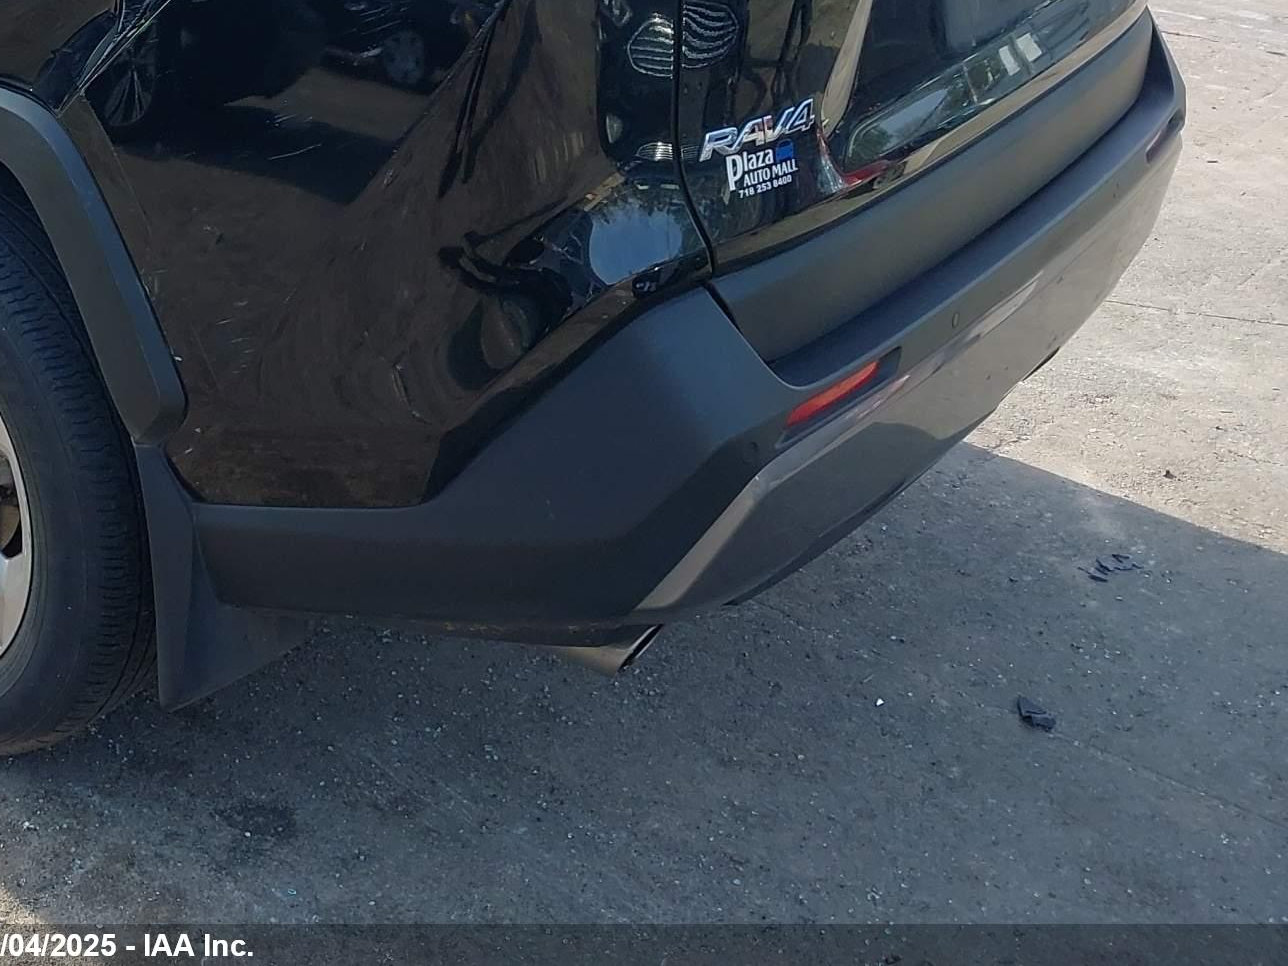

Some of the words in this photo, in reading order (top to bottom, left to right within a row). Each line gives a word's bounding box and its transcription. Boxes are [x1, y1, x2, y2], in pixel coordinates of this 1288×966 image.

[698, 98, 815, 163] RAV4
[725, 148, 775, 191] Plaza
[743, 167, 771, 188] AUTO
[771, 158, 799, 178] MALL
[738, 186, 756, 199] 718
[756, 181, 773, 194] 253
